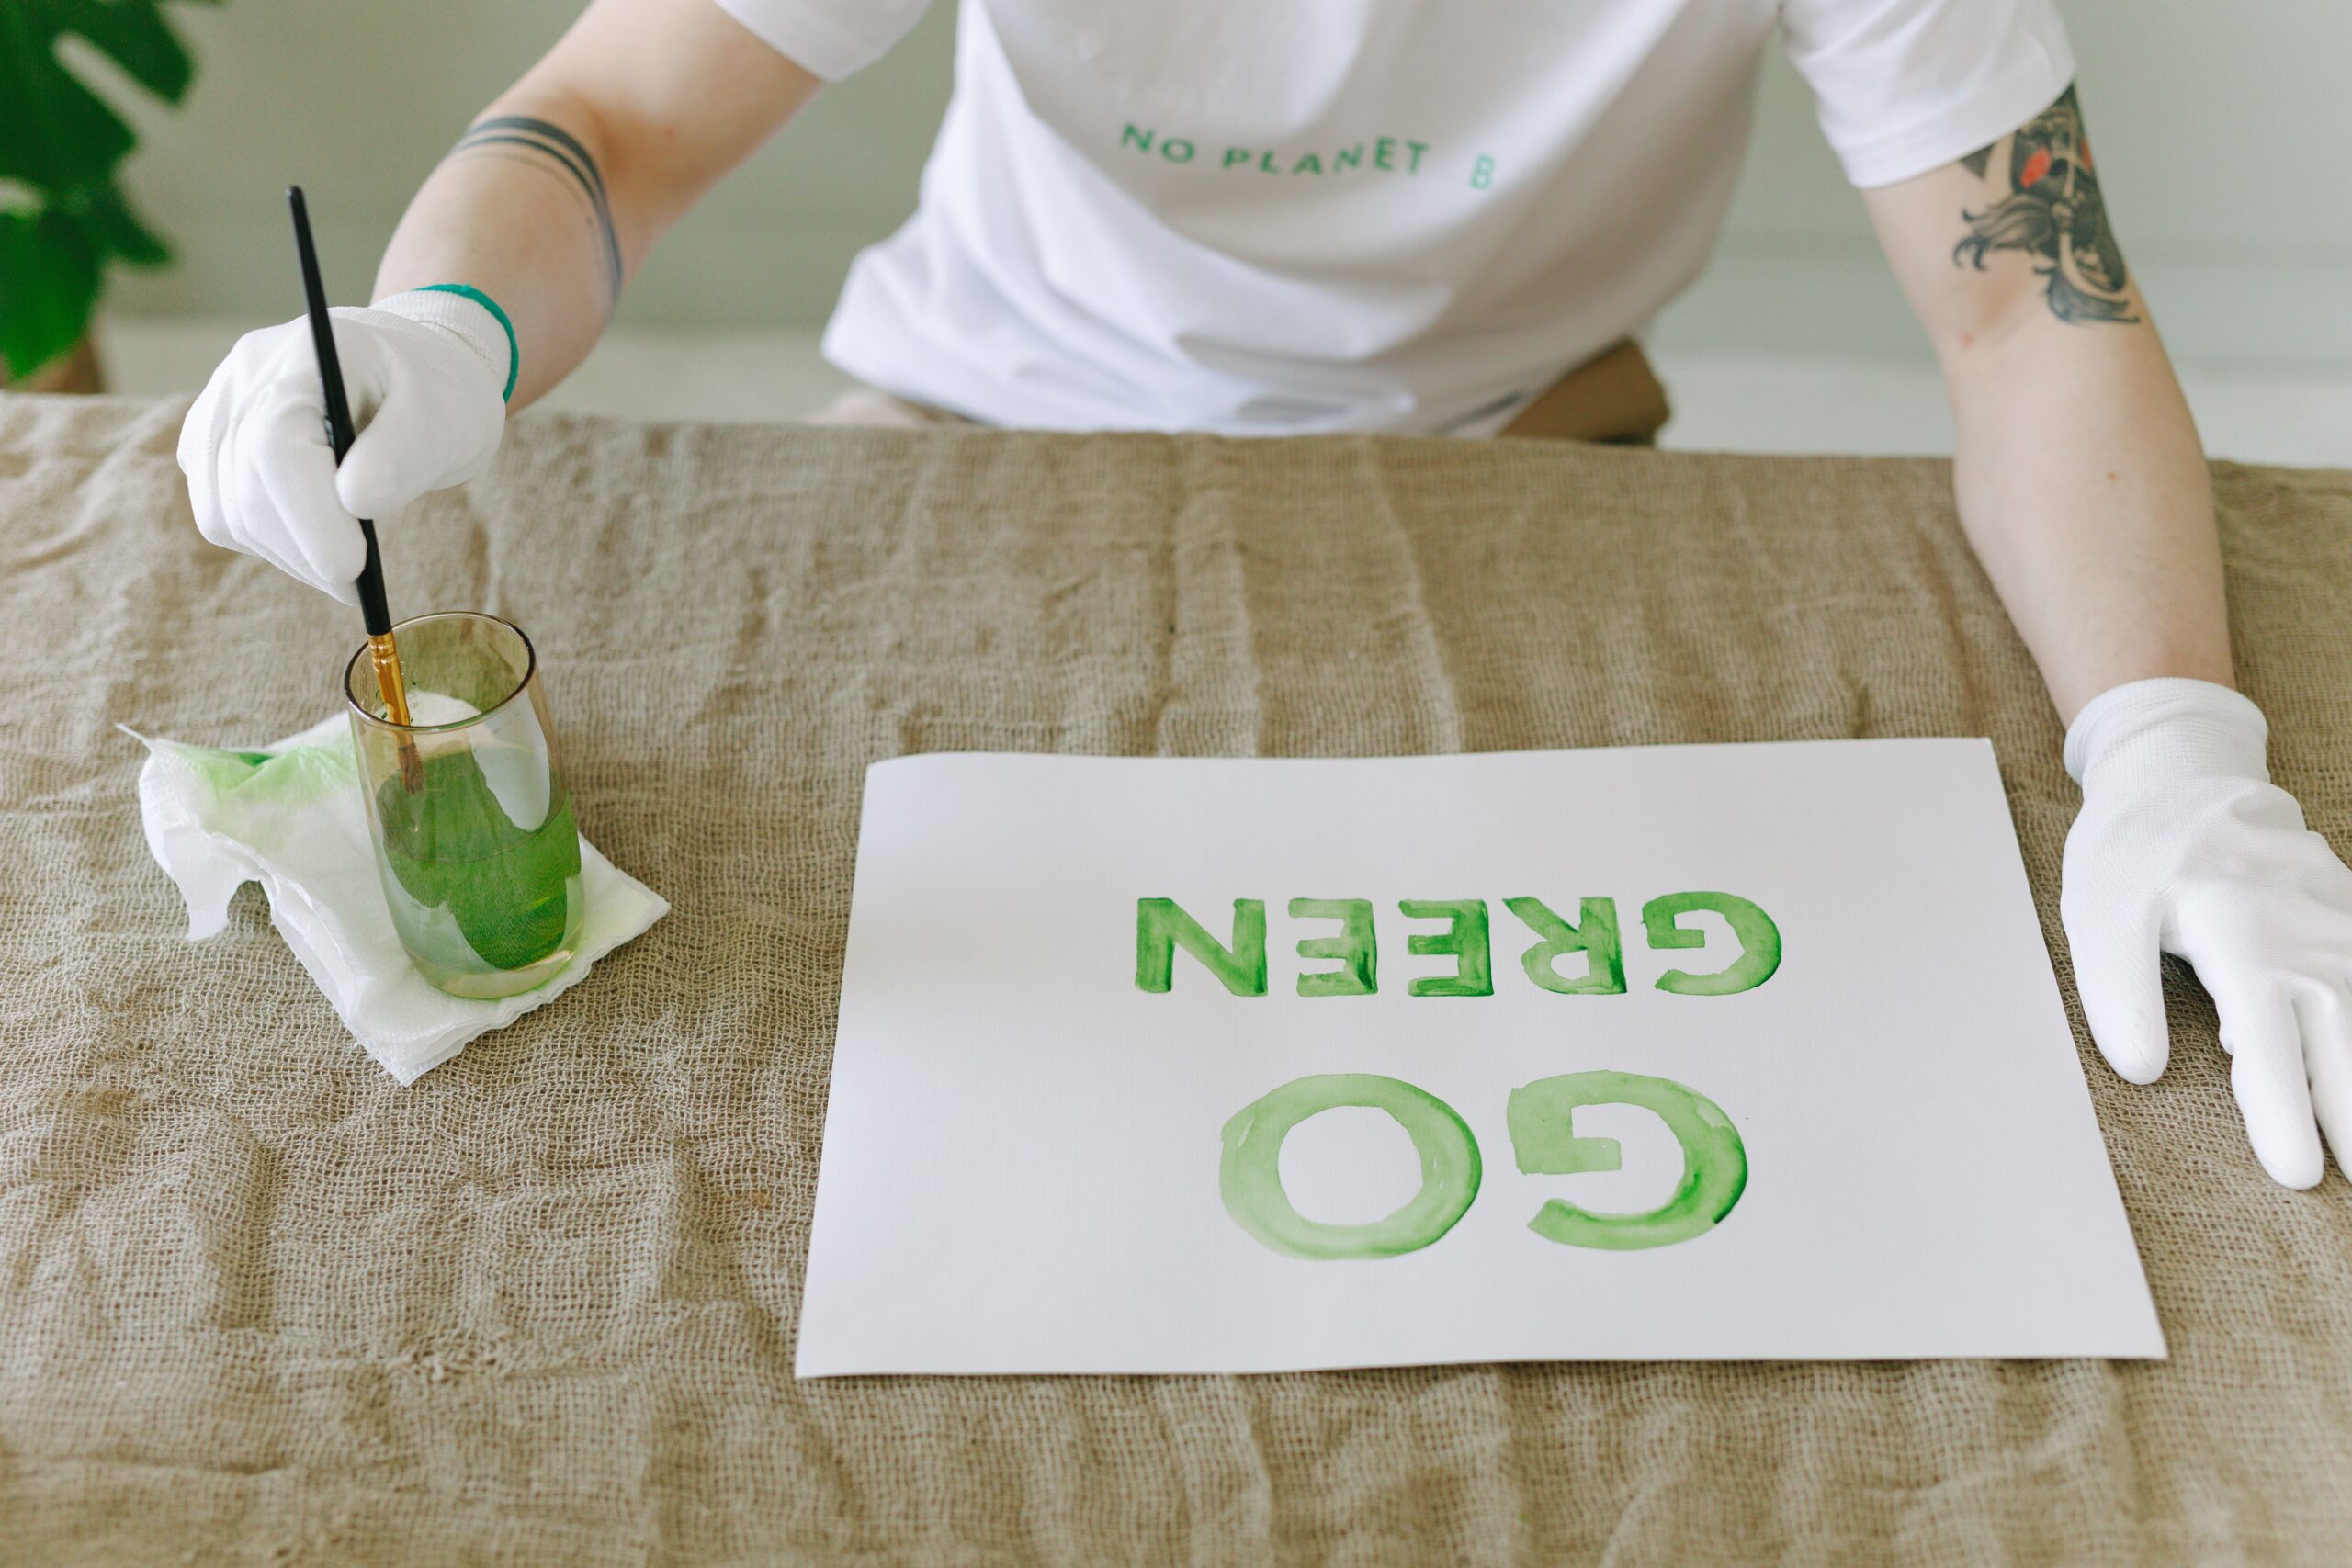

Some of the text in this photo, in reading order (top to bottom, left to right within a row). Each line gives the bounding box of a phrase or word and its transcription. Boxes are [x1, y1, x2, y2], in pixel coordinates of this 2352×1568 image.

[1121, 123, 1497, 191] NO PLANET B
[1134, 890, 1783, 998] GREEN
[1219, 1070, 1750, 1261] GO
